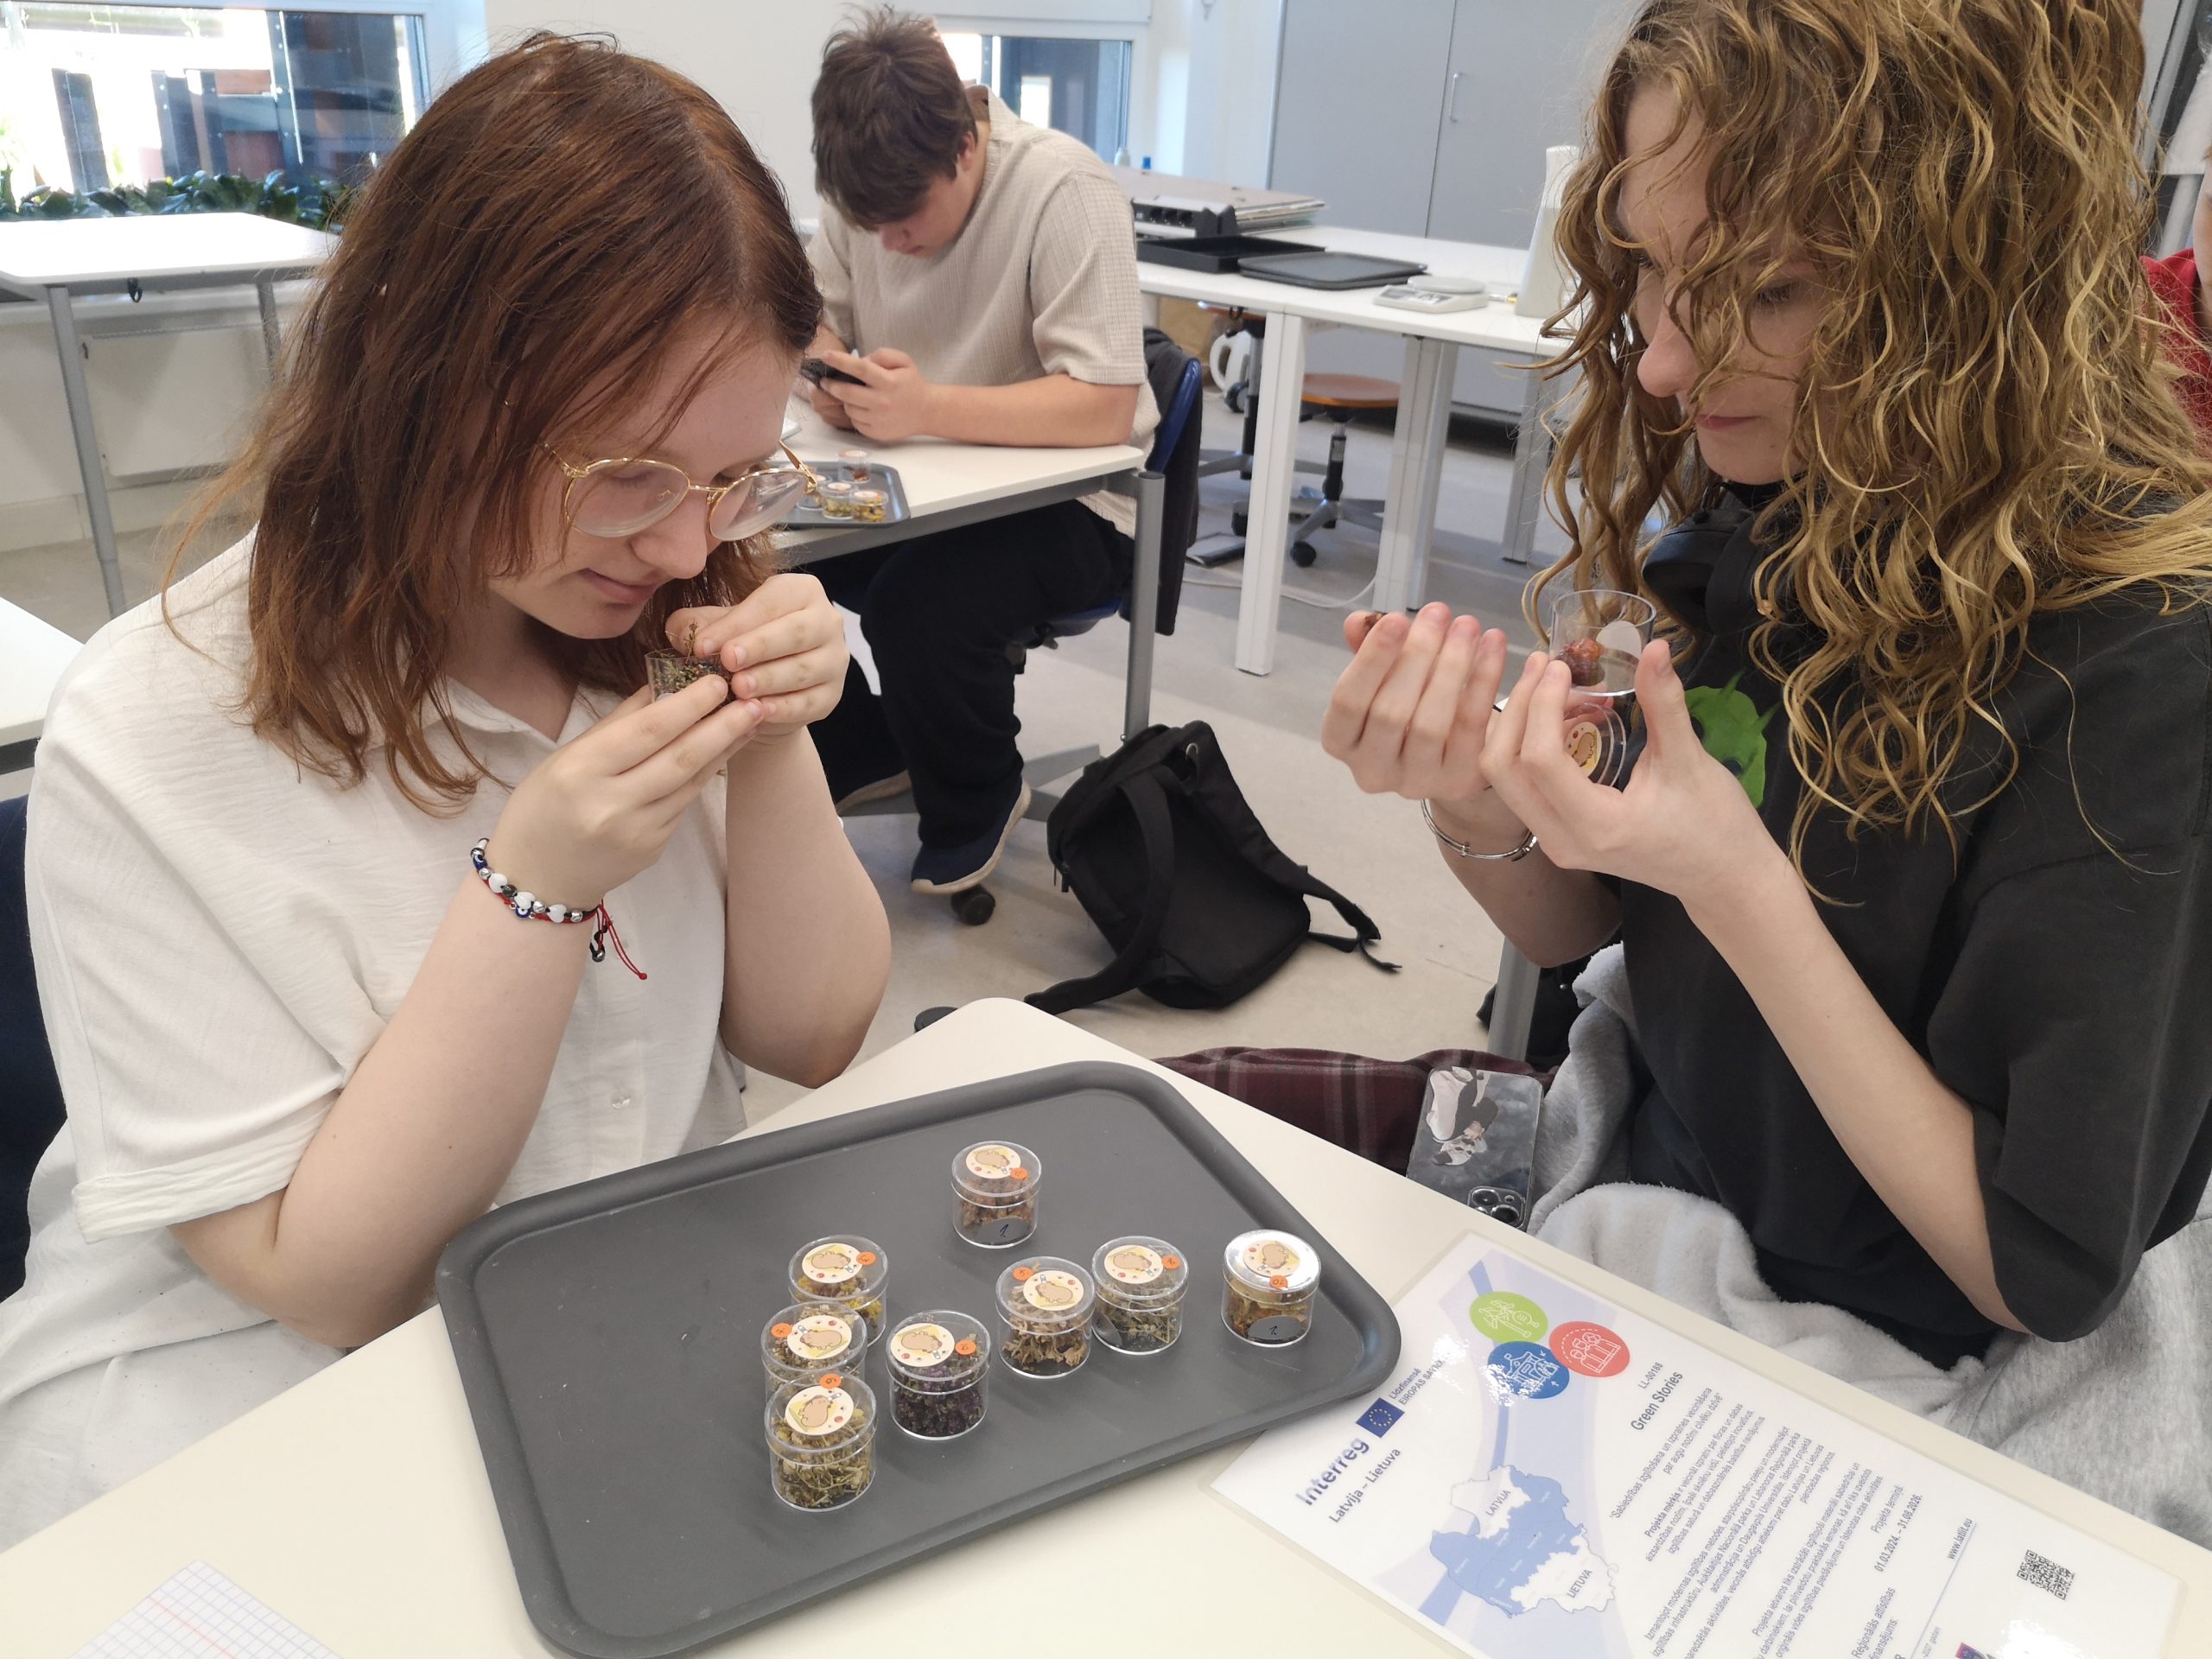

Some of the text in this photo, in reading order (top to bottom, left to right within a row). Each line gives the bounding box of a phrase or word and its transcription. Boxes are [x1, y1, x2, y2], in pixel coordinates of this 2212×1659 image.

[1637, 1362, 1663, 1389] LL-00188
[1398, 1379, 1426, 1405] EIROPAS
[1630, 1372, 1683, 1430] Green Stories
[1662, 1442, 1672, 1452] un
[1662, 1462, 1674, 1475] par
[1670, 1447, 1685, 1463] augu
[1296, 1438, 1370, 1506] Interreg
[1760, 1458, 1769, 1466] un
[1329, 1490, 1363, 1522] Latvija
[1365, 1449, 1402, 1483] Lietuva
[1644, 1512, 1667, 1537] Projekta
[1663, 1492, 1681, 1513] mērķis
[1707, 1439, 1718, 1450] par
[1724, 1418, 1733, 1427] un
[1485, 1490, 1511, 1516] LATVIJA
[1697, 1502, 1707, 1510] un
[1748, 1500, 1758, 1509] un
[1774, 1506, 1786, 1521] pret
[1780, 1493, 1794, 1508] dabu
[1871, 1508, 1891, 1534] Projekta
[1874, 1535, 1901, 1572] 01.03.2024.
[1897, 1494, 1923, 1529] 31.08.2026.
[1736, 1543, 1745, 1553] un
[1751, 1609, 1774, 1637] Projekta
[1783, 1573, 1795, 1586] tiks
[1852, 1462, 1860, 1471] un
[1947, 1518, 1973, 1560] www.latlit.eu
[1567, 1569, 1592, 1599] LIETUVA
[1791, 1612, 1805, 1630] vides
[1837, 1541, 1847, 1549] un
